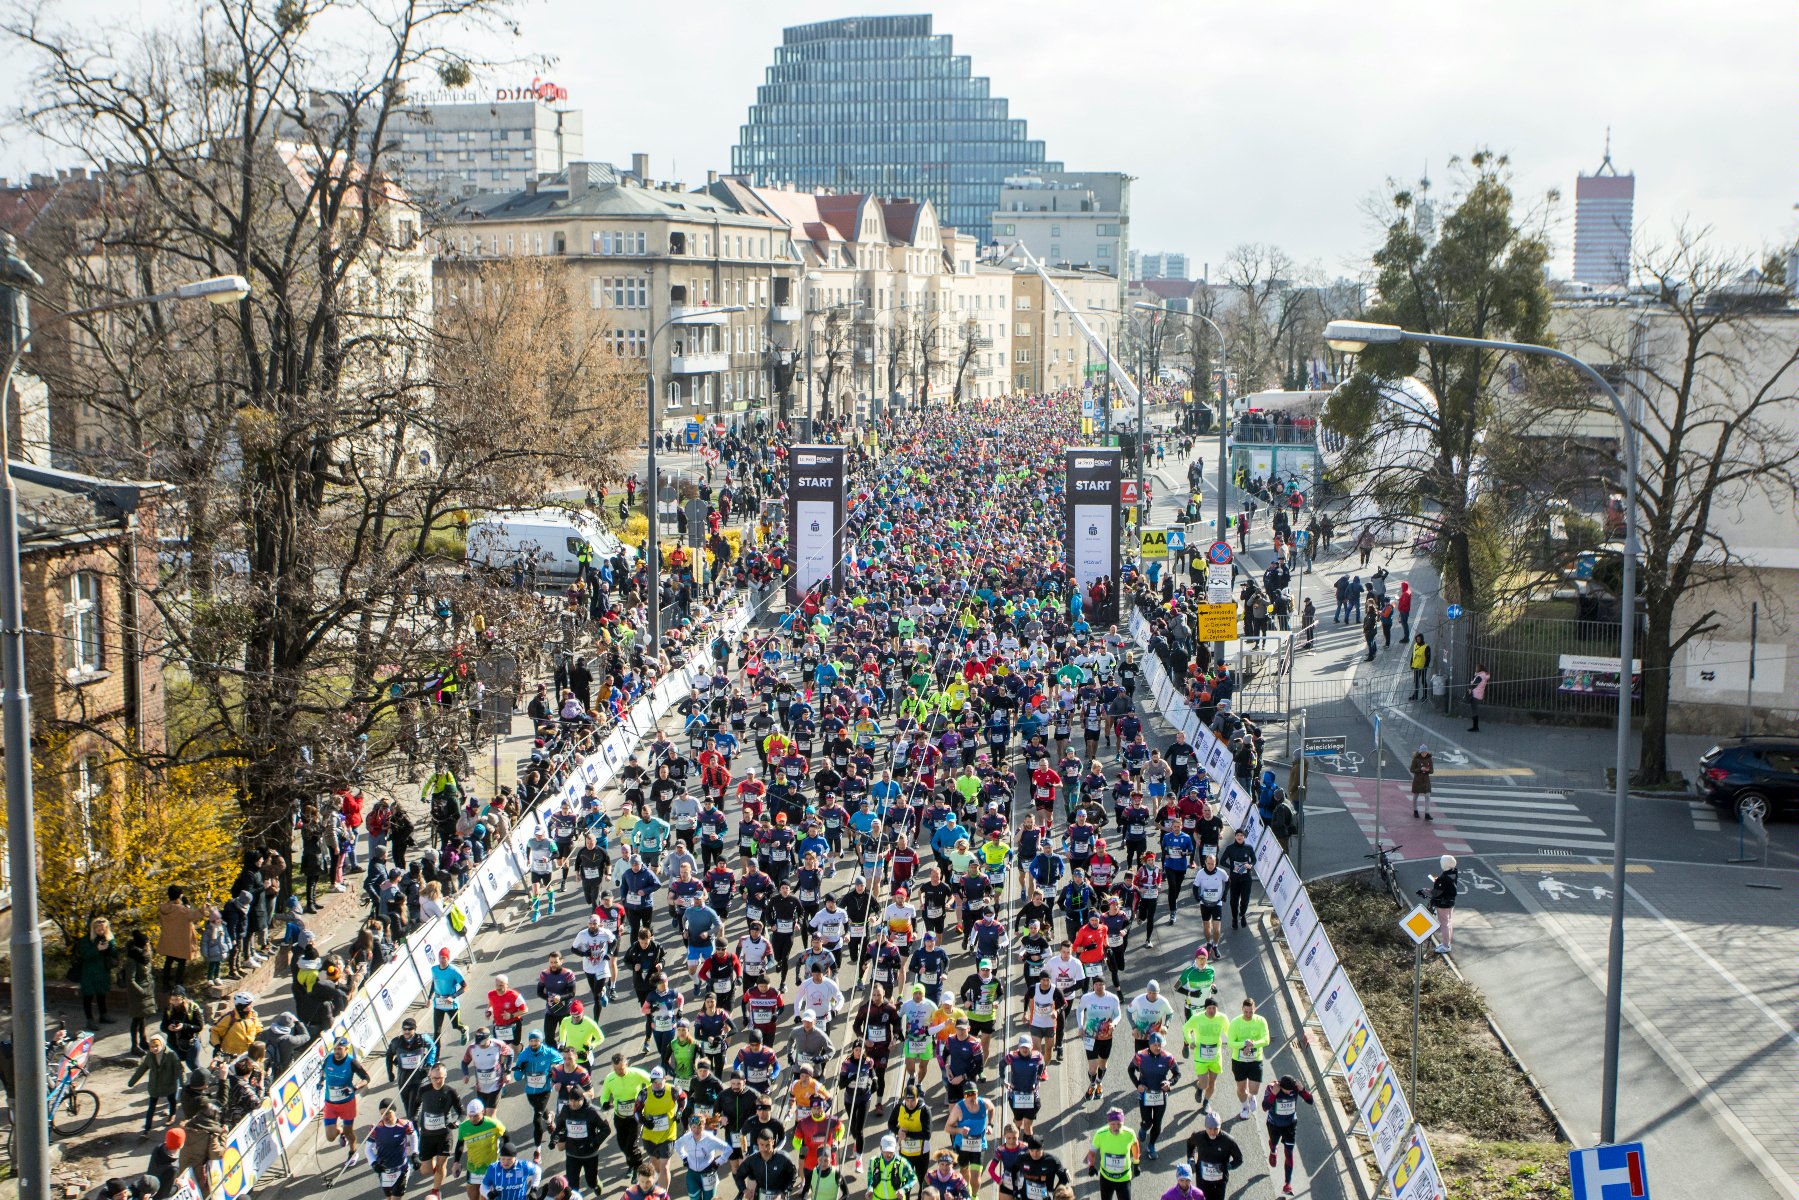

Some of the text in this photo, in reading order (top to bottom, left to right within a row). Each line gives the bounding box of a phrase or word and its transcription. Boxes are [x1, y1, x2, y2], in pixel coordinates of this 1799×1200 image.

[798, 477, 833, 487] START
[1075, 480, 1111, 491] START
[1125, 483, 1138, 496] A
[1142, 532, 1167, 545] AA
[1305, 742, 1345, 752] Święcickiego
